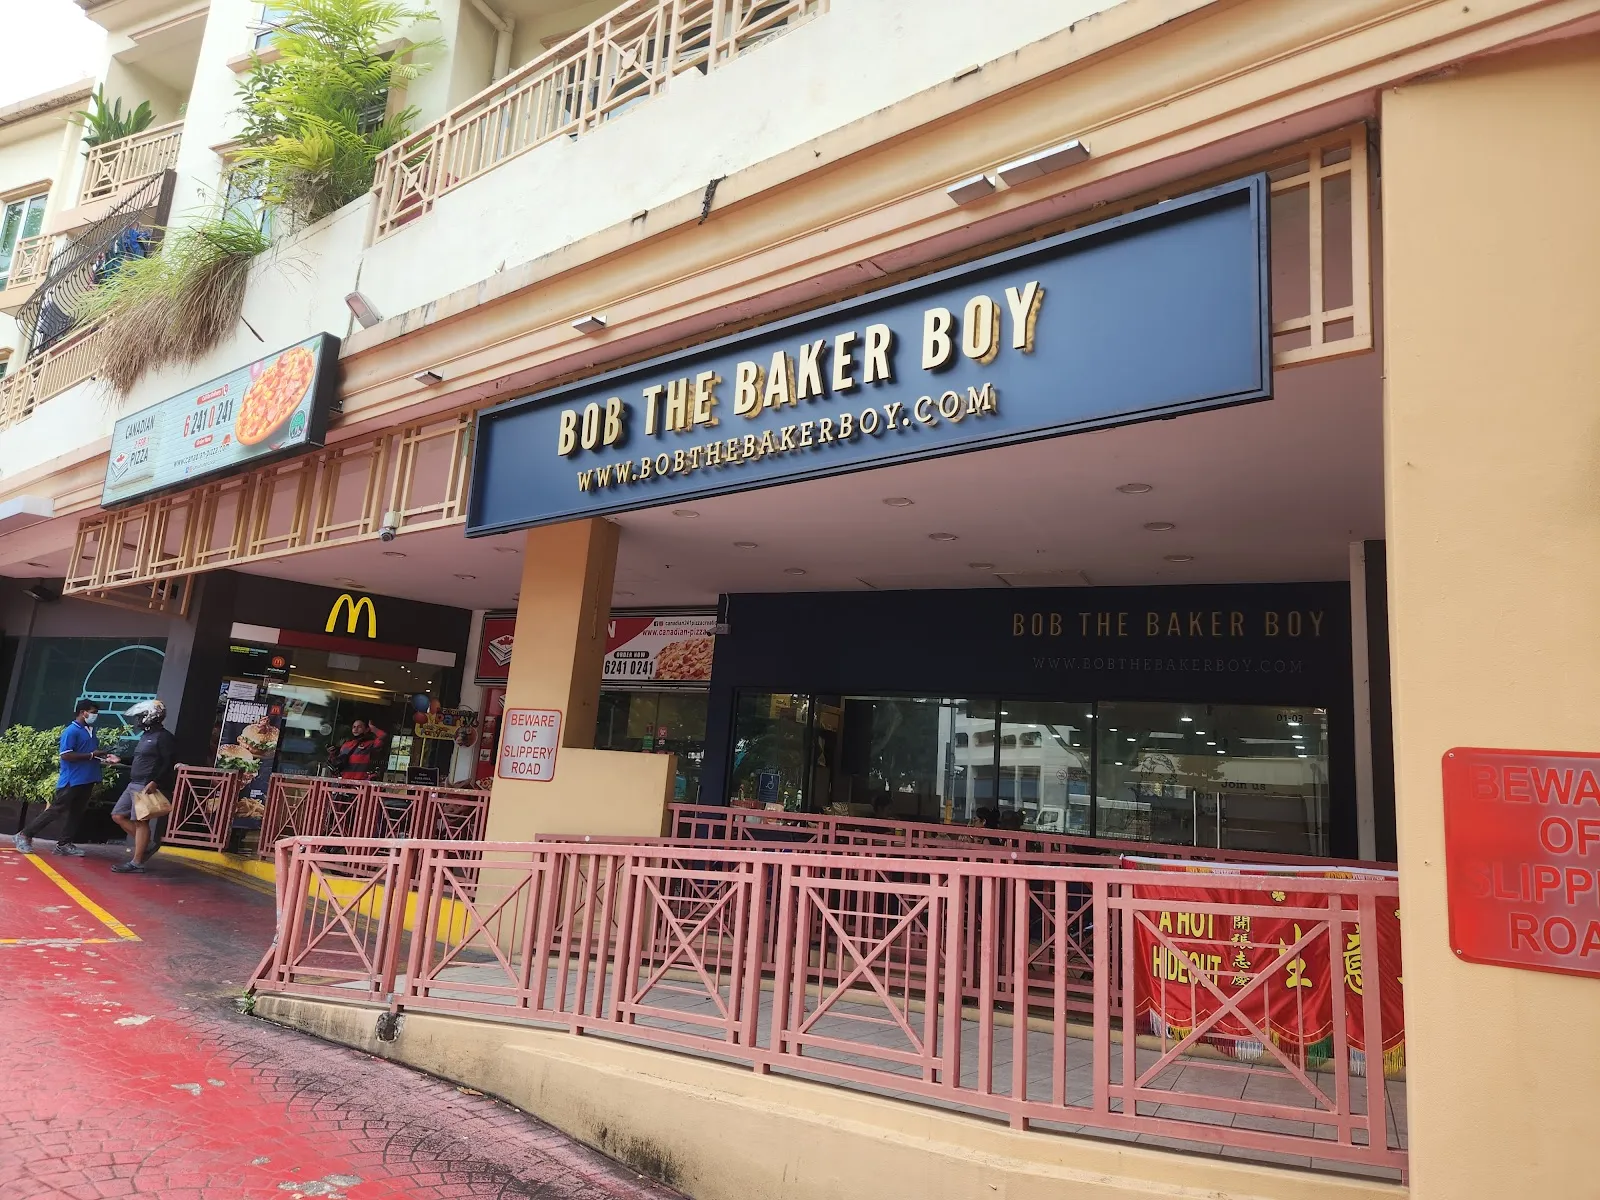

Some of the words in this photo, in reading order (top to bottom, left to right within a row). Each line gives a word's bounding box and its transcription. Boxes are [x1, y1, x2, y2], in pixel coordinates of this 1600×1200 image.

[557, 396, 624, 456] BOB
[643, 369, 717, 436] THE
[734, 323, 893, 418] BAKER
[921, 279, 1042, 370] BOY
[184, 414, 191, 437] 6
[191, 408, 208, 434] 241
[208, 405, 215, 428] 0
[216, 398, 233, 425] 241
[125, 414, 156, 440] CANADIAN
[577, 382, 997, 492] WWW.BOBTHEBAKERBOY.COM
[129, 447, 149, 467] PIZZA
[1013, 613, 1063, 636] BOB
[1079, 612, 1129, 636] THE
[1147, 611, 1245, 636] BAKER
[1265, 610, 1325, 636] BOY
[604, 659, 627, 675] 6241
[630, 660, 654, 675] 0241
[1032, 657, 1305, 673] WWW.BOBTHEBAKERBOY.COM
[226, 711, 261, 724] BURGER
[228, 702, 268, 717] SAMURAI
[1276, 713, 1304, 723] 01-03
[510, 713, 556, 728] BEWARE
[523, 730, 538, 742] OF
[503, 745, 555, 760] SLIPPERY
[511, 761, 541, 775] ROAD
[1221, 778, 1247, 790] Join
[1252, 782, 1266, 791] us
[1539, 815, 1600, 856] OF
[1462, 860, 1600, 907] SLIPP
[1159, 911, 1173, 933] A
[1177, 912, 1214, 939] HOT
[1153, 945, 1222, 988] HIDEOUT
